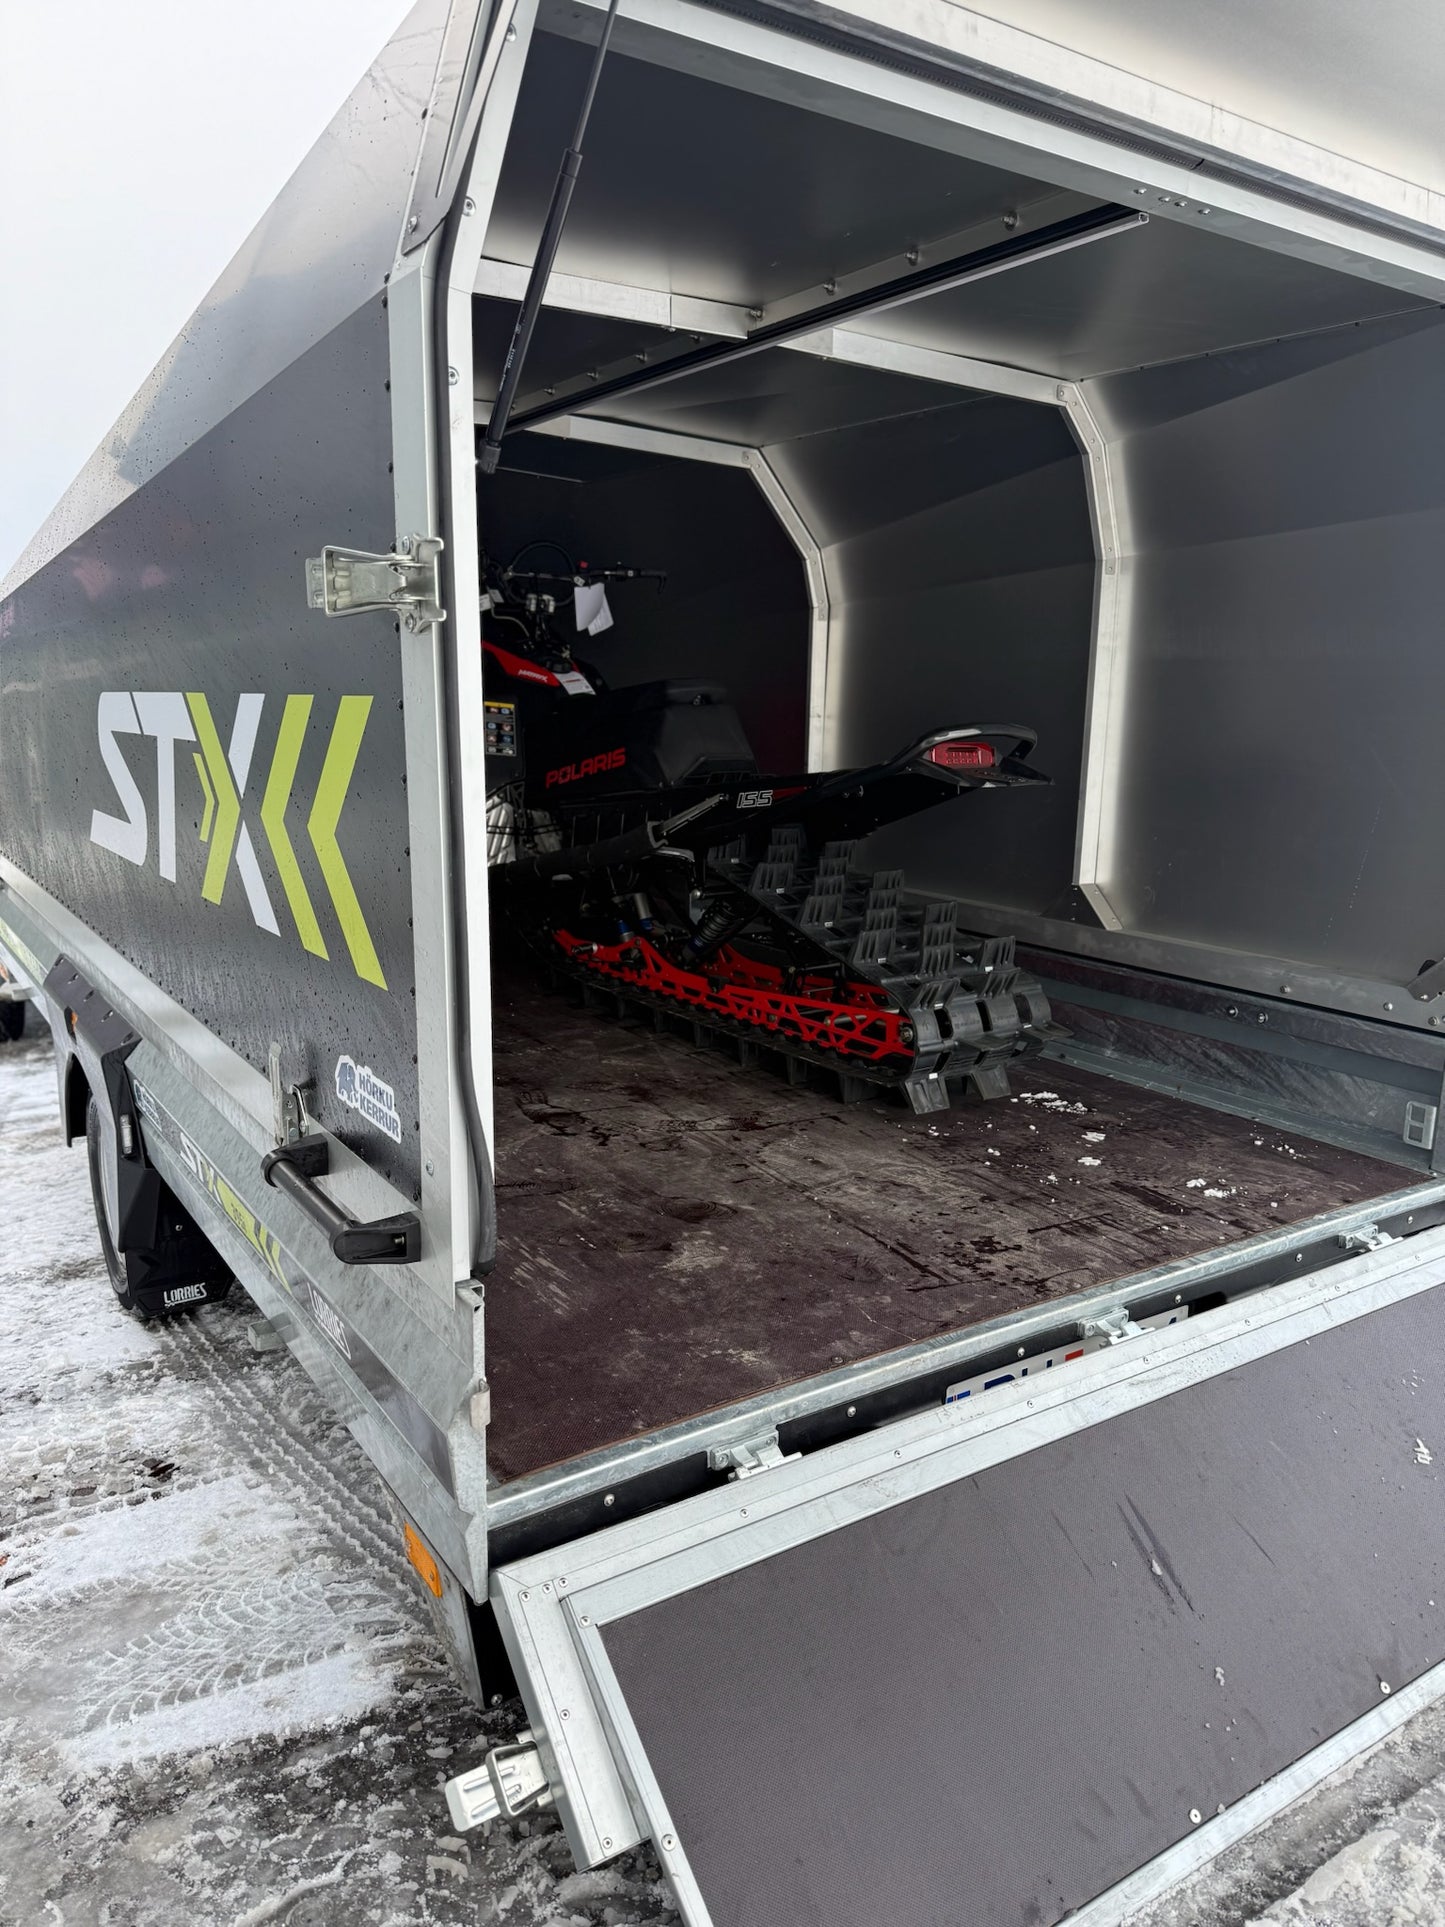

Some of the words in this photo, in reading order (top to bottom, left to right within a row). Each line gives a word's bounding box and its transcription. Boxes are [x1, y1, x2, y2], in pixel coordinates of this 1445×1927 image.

[545, 747, 626, 789] POLARIS
[90, 691, 281, 938] STX
[736, 789, 774, 808] 155
[359, 1071, 393, 1112] HÖRKU
[359, 1092, 400, 1138] KERRUR
[163, 1282, 207, 1307] LORRIES
